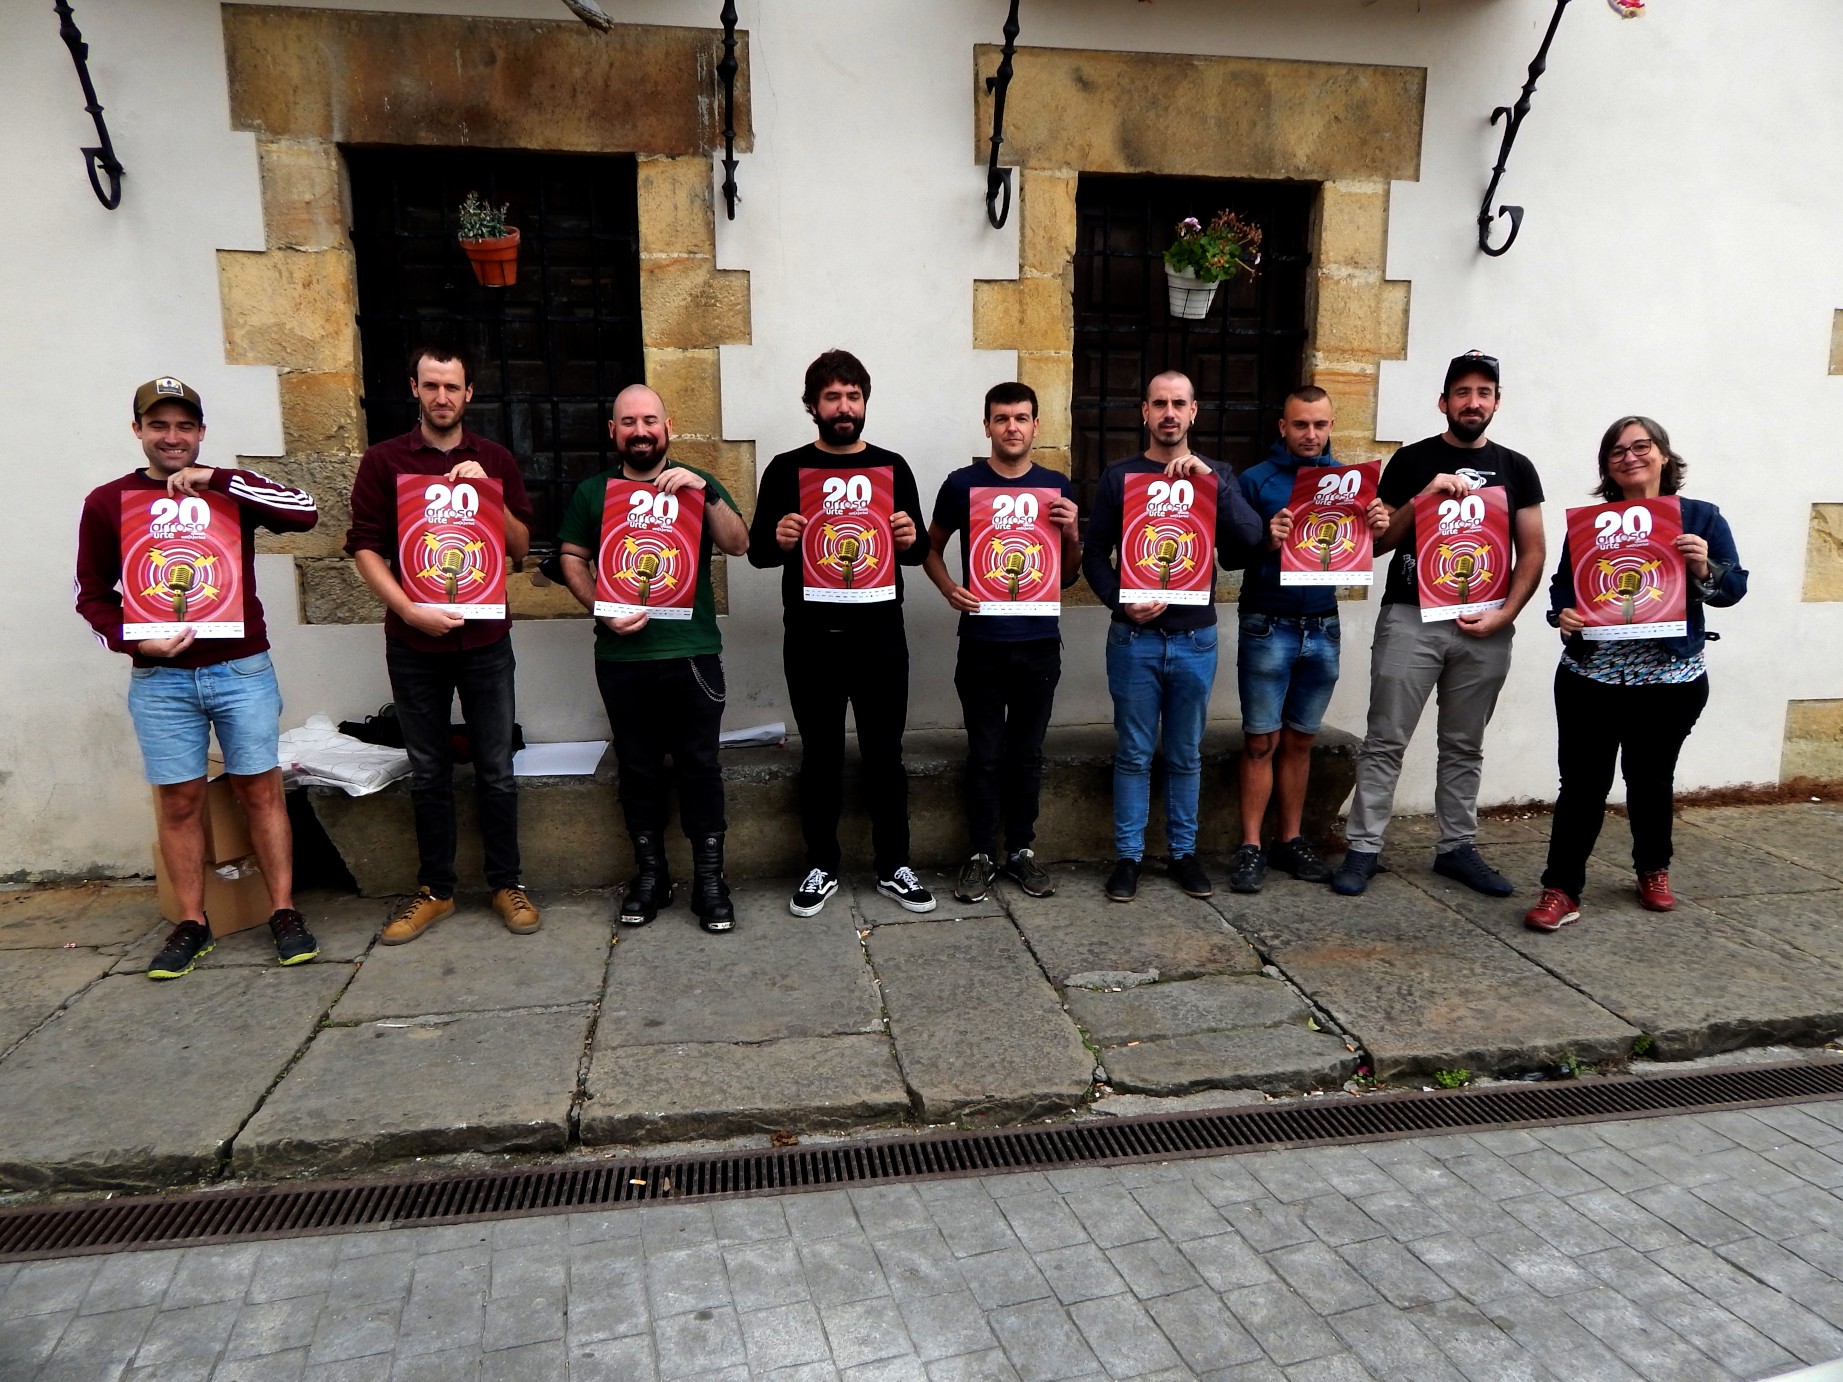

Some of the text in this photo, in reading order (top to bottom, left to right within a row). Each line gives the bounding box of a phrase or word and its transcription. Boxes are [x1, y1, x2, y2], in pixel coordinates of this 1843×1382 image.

[822, 474, 872, 509] 20
[1146, 480, 1194, 511] 20
[1314, 469, 1362, 500] 20
[151, 497, 210, 532] 20
[424, 483, 479, 518] 20
[426, 508, 475, 519] arrosa
[627, 490, 679, 524] 20
[824, 500, 868, 510] arrosa
[992, 493, 1039, 524] 20
[1147, 503, 1190, 513] arrosa
[1438, 495, 1486, 530] 20
[152, 523, 205, 533] arrosa
[628, 512, 673, 526] arrosa
[993, 516, 1035, 526] arrosa
[1439, 518, 1482, 532] arrosa
[1594, 505, 1653, 545] 20
[1597, 530, 1649, 545] arrosa
